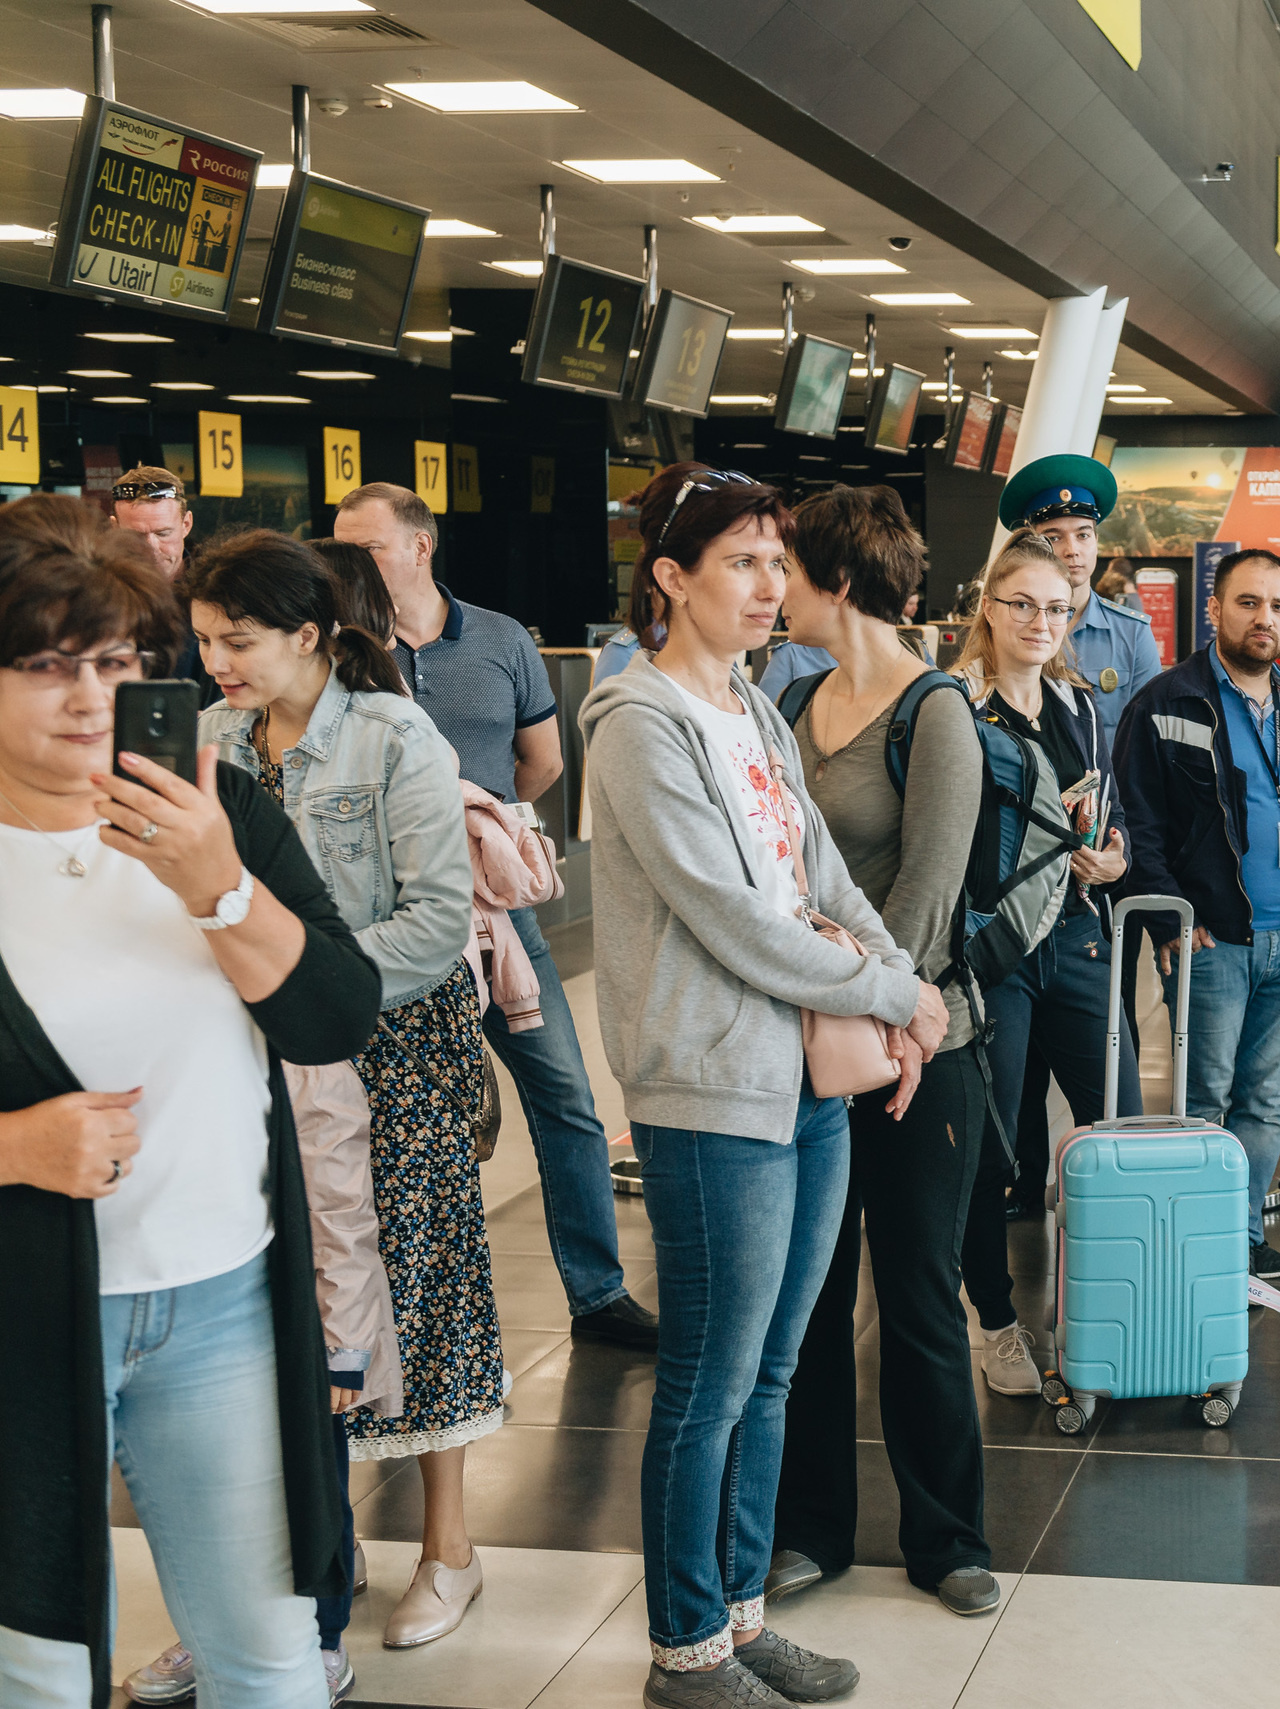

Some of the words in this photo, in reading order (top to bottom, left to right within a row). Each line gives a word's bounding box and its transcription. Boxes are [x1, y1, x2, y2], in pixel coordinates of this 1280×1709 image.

[109, 117, 160, 142] АЭРОФЛОТ
[96, 157, 125, 195] ALL
[127, 165, 191, 213] FLIGHTS
[203, 157, 249, 183] РОССИЯ
[89, 204, 183, 256] CHECK-IN
[108, 255, 152, 292] Utair
[295, 253, 357, 281] Бизнес-класс
[185, 279, 215, 298] Airlines
[290, 272, 331, 296] Business
[331, 282, 354, 300] class
[576, 295, 613, 354] 12
[676, 326, 707, 377] 13
[208, 428, 235, 470] 15
[331, 443, 354, 481] 16
[421, 455, 440, 490] 17
